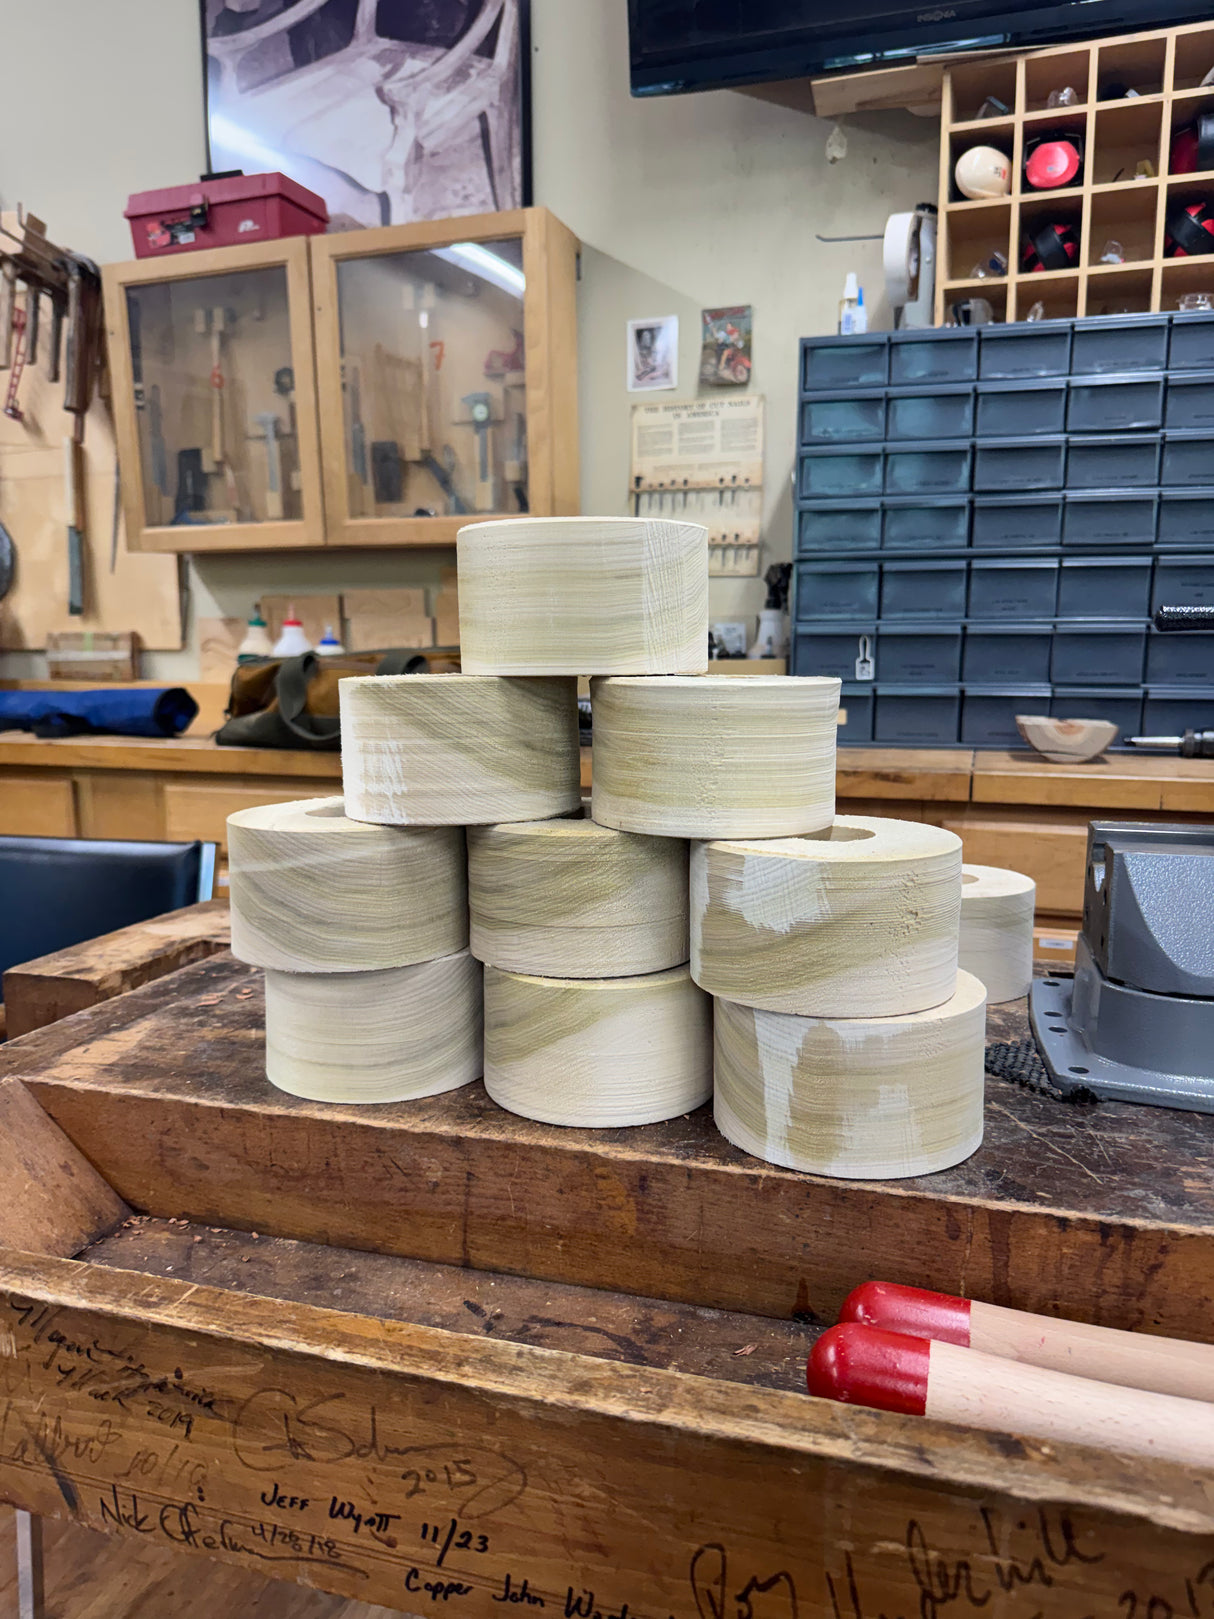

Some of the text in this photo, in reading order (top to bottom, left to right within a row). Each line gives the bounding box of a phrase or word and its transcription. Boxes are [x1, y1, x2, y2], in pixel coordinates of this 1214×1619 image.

[147, 1400, 194, 1438] 2019
[401, 1459, 477, 1499] 2015
[100, 1484, 156, 1532] Nick
[420, 1518, 489, 1567] 11/23
[492, 1573, 545, 1608] John
